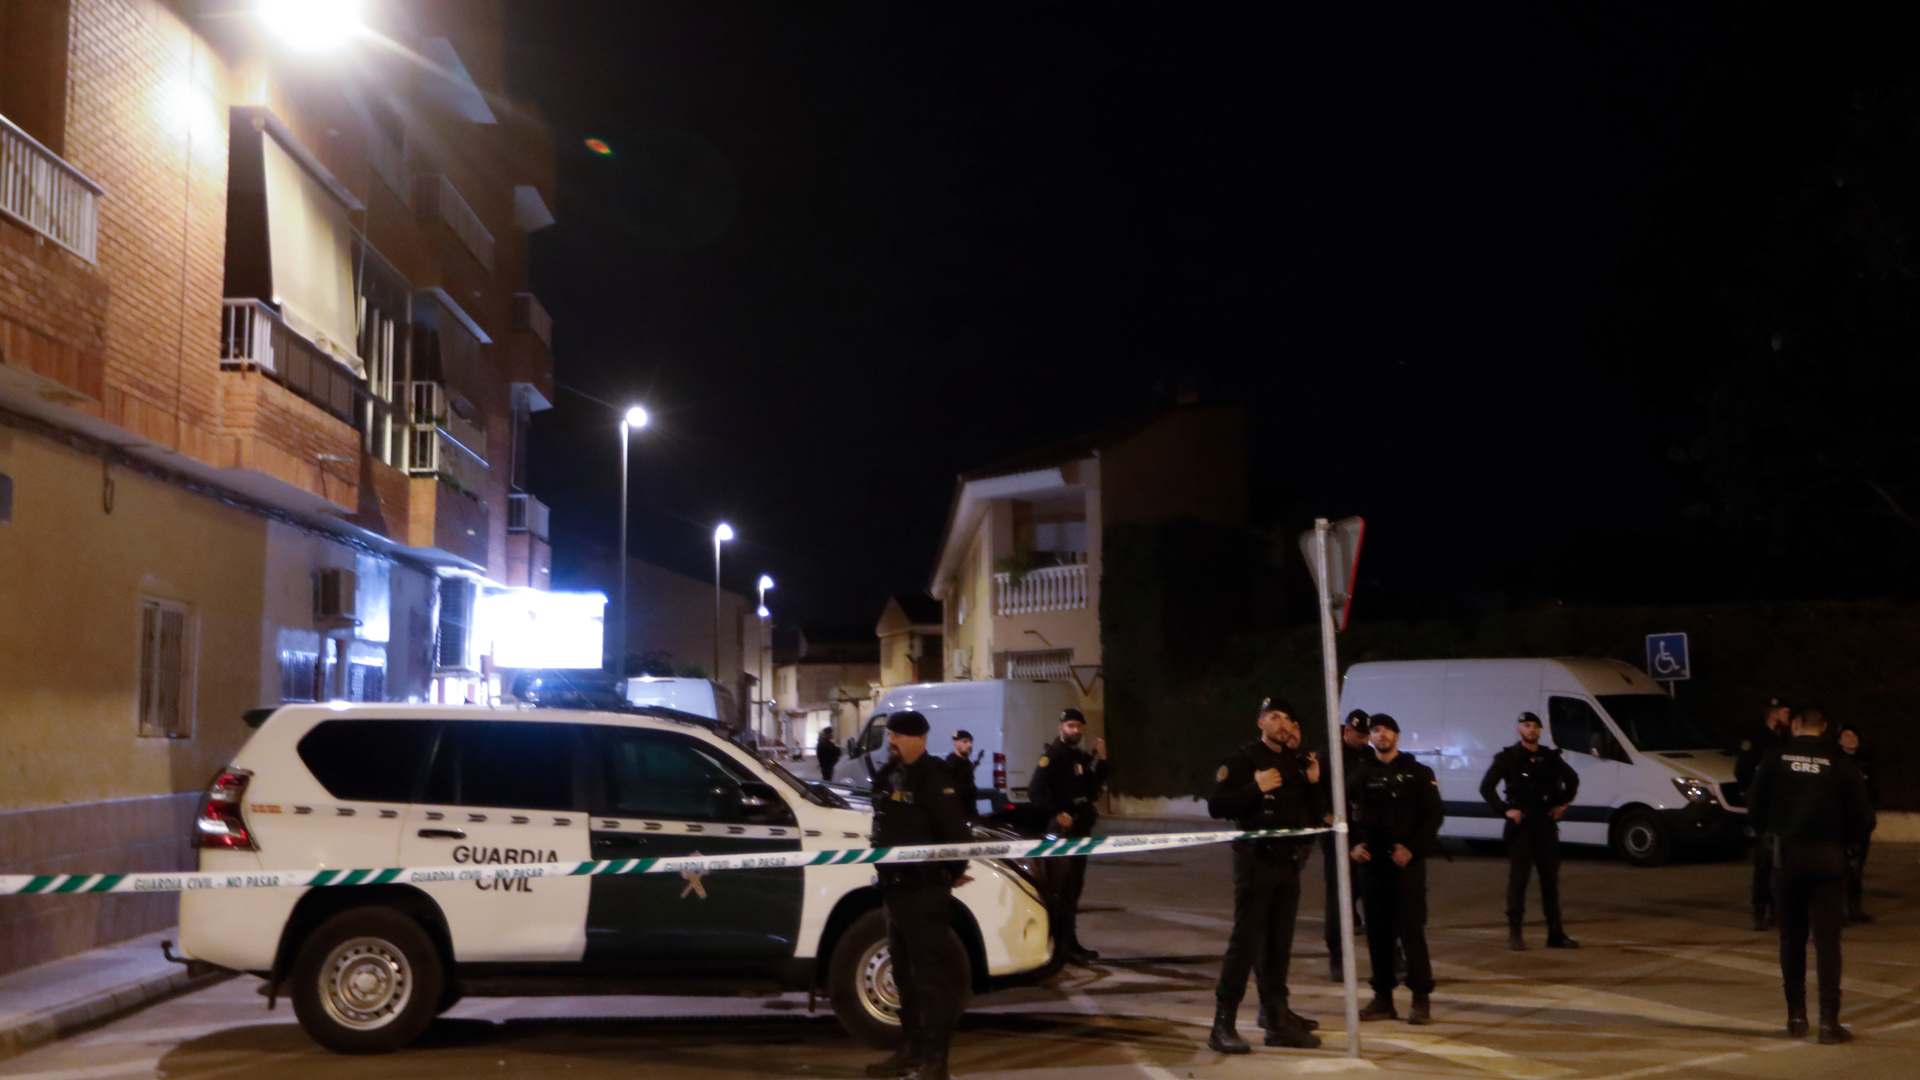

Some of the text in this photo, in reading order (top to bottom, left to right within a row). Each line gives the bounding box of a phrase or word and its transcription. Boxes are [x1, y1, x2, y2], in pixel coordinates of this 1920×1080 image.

[1791, 762, 1820, 774] GRS
[453, 845, 558, 864] GUARDIA
[664, 862, 705, 872] GUARDIA
[742, 858, 756, 869] NO
[759, 857, 787, 867] PASAR
[411, 870, 455, 883] GUARDIA
[459, 870, 482, 881] CIVIL
[495, 869, 511, 879] NO
[514, 868, 544, 878] PASAR
[134, 877, 182, 891] GUARDIA
[187, 877, 213, 889] CIVIL
[226, 876, 242, 888] NO
[246, 876, 280, 887] PASAR
[475, 878, 533, 892] CIVIL
